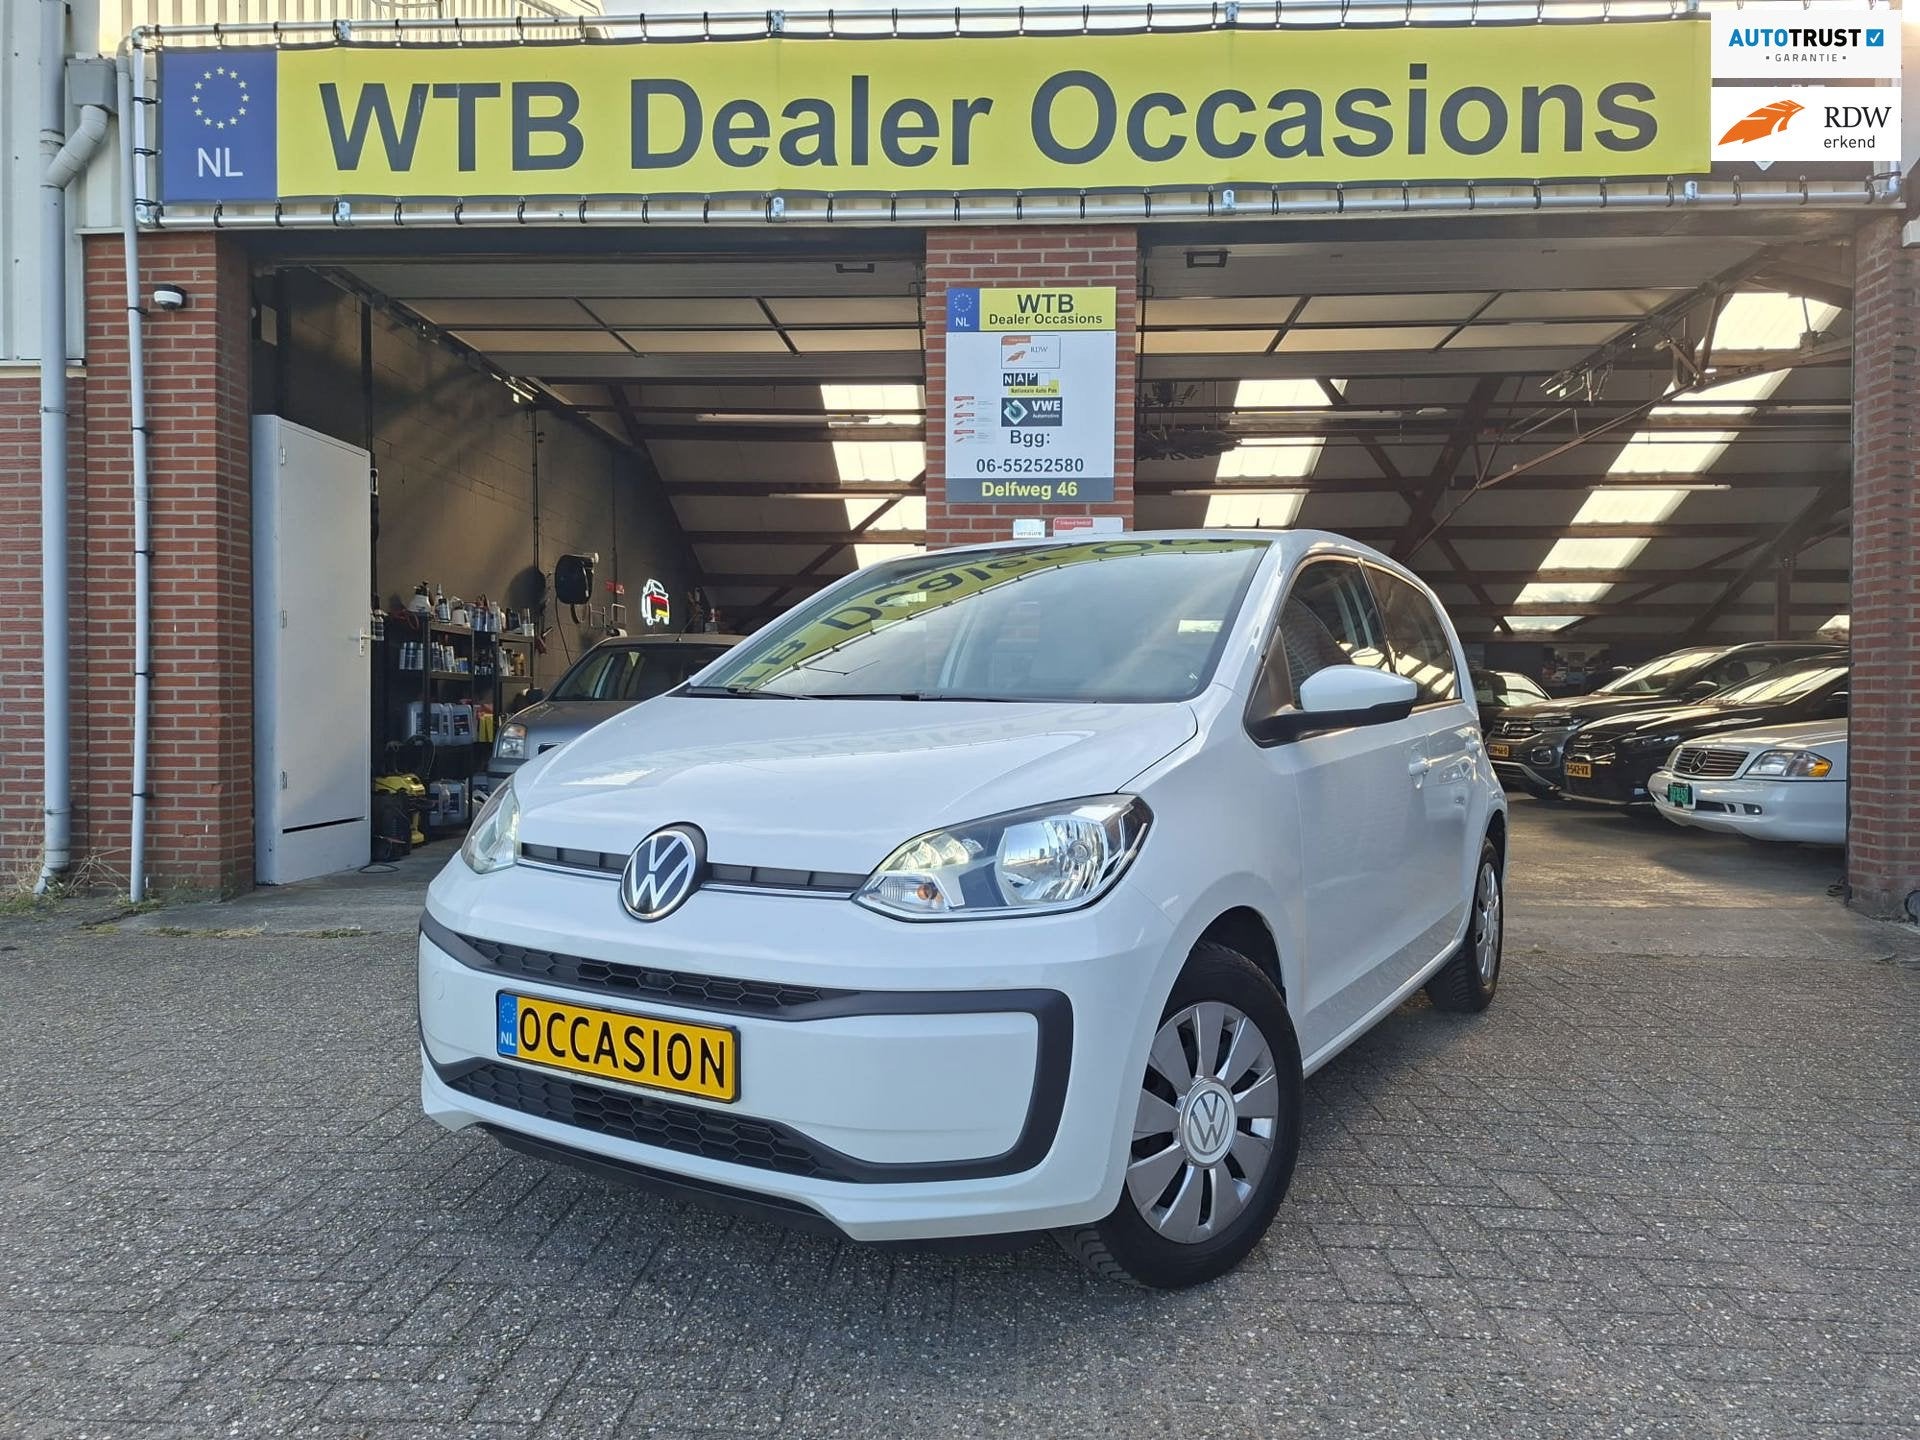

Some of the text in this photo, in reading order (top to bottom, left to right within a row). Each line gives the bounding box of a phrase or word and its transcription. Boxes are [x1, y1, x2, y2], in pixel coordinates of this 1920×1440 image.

[318, 62, 1659, 172] WTB Dealer Occasions
[197, 146, 244, 178] NL
[1017, 293, 1074, 313] WTB
[955, 317, 971, 327] NL
[989, 313, 1103, 325] Dealer Occasions
[1003, 372, 1038, 385] NAP
[1031, 400, 1061, 411] VWE
[1010, 430, 1051, 448] Bgg:
[976, 458, 1085, 473] 06-55252580
[981, 481, 1078, 500] Delfweg 46
[500, 1031, 516, 1047] NL
[518, 1007, 725, 1089] OCCASION
